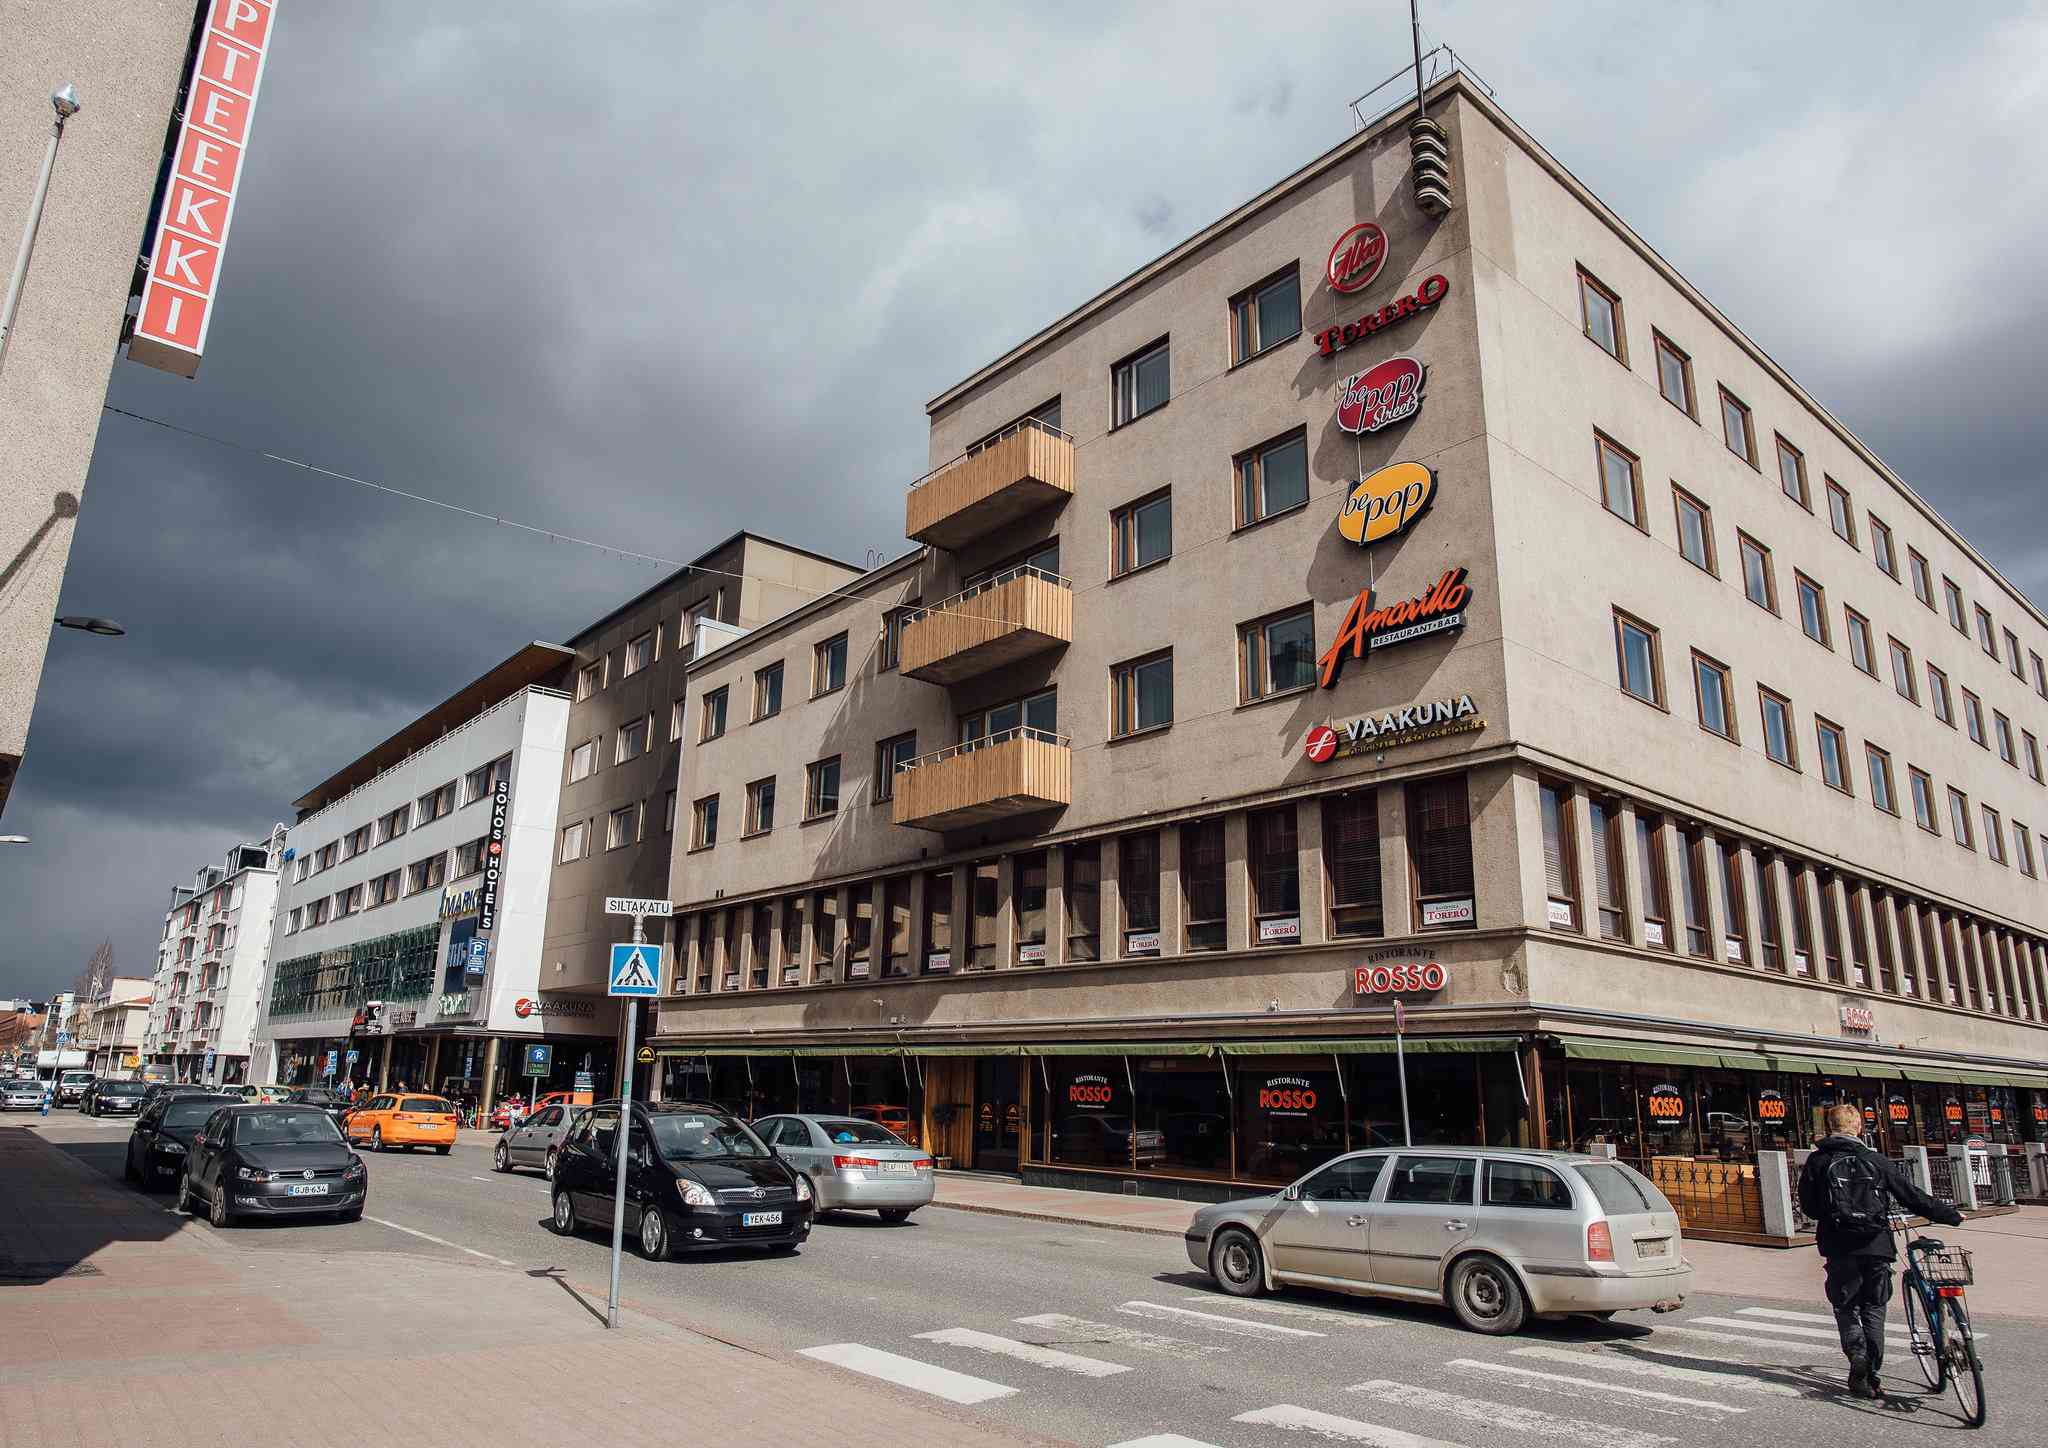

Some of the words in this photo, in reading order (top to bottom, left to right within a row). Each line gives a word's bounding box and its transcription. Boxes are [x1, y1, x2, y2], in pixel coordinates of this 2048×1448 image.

[1317, 567, 1470, 689] Amarillo
[1345, 695, 1478, 741] VAAKUNA
[492, 781, 508, 840] SOKOS
[482, 856, 499, 929] HOTELS
[610, 900, 670, 914] SILTAKATU
[1367, 945, 1436, 963] RISTORANTE
[1354, 962, 1448, 993] ROSSO
[1267, 1077, 1310, 1088] RISTORANTE
[1070, 1086, 1112, 1102] ROSSO
[1260, 1088, 1316, 1109] ROSSO
[1649, 1096, 1683, 1116] ROSSO
[1759, 1100, 1785, 1117] ROSSO
[751, 1214, 780, 1224] YEK-456
